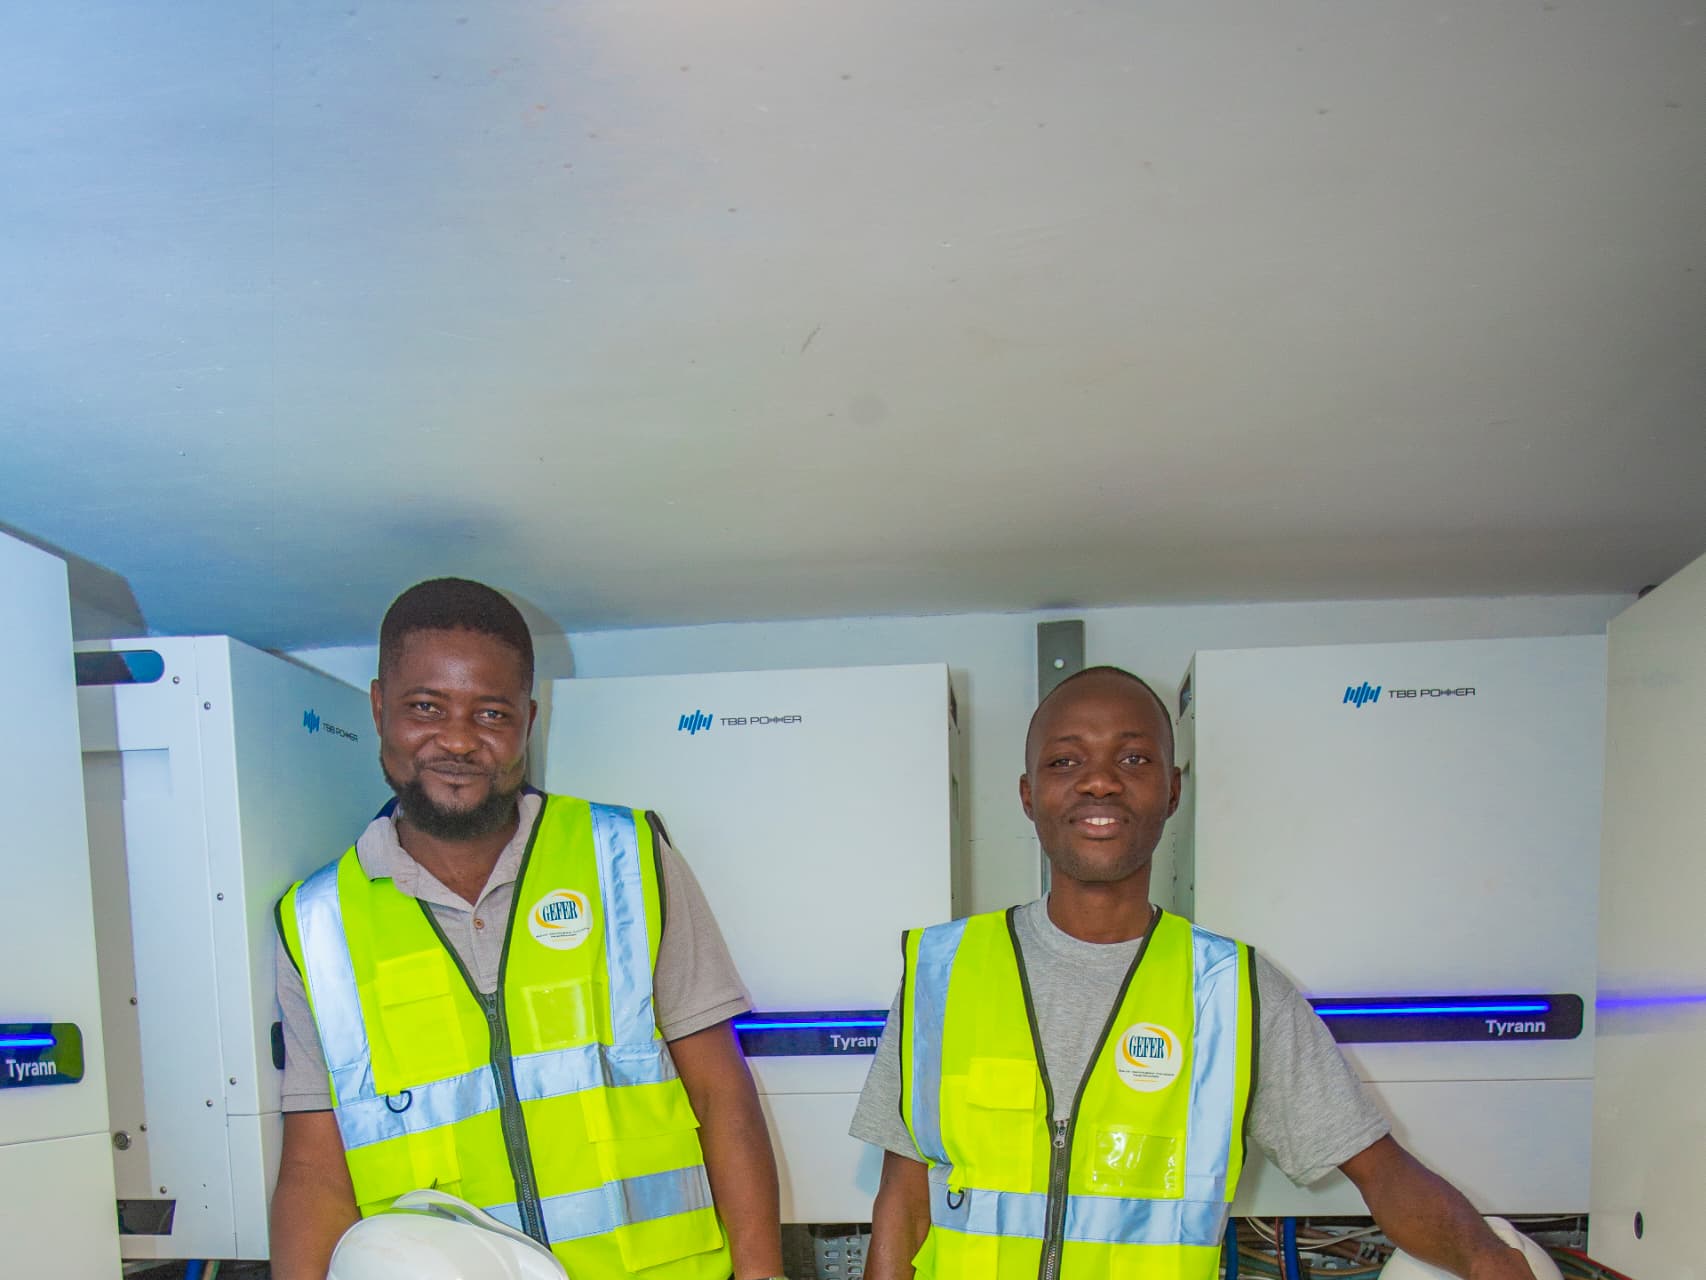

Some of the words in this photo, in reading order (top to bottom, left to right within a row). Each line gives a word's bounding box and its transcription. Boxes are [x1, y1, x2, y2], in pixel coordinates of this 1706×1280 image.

[1388, 689, 1416, 699] TBB
[719, 717, 747, 727] TBB
[542, 900, 578, 922] GEFER
[1485, 1019, 1546, 1037] Tyrann
[1129, 1034, 1165, 1059] GEFER
[5, 1059, 57, 1081] Tyrann
